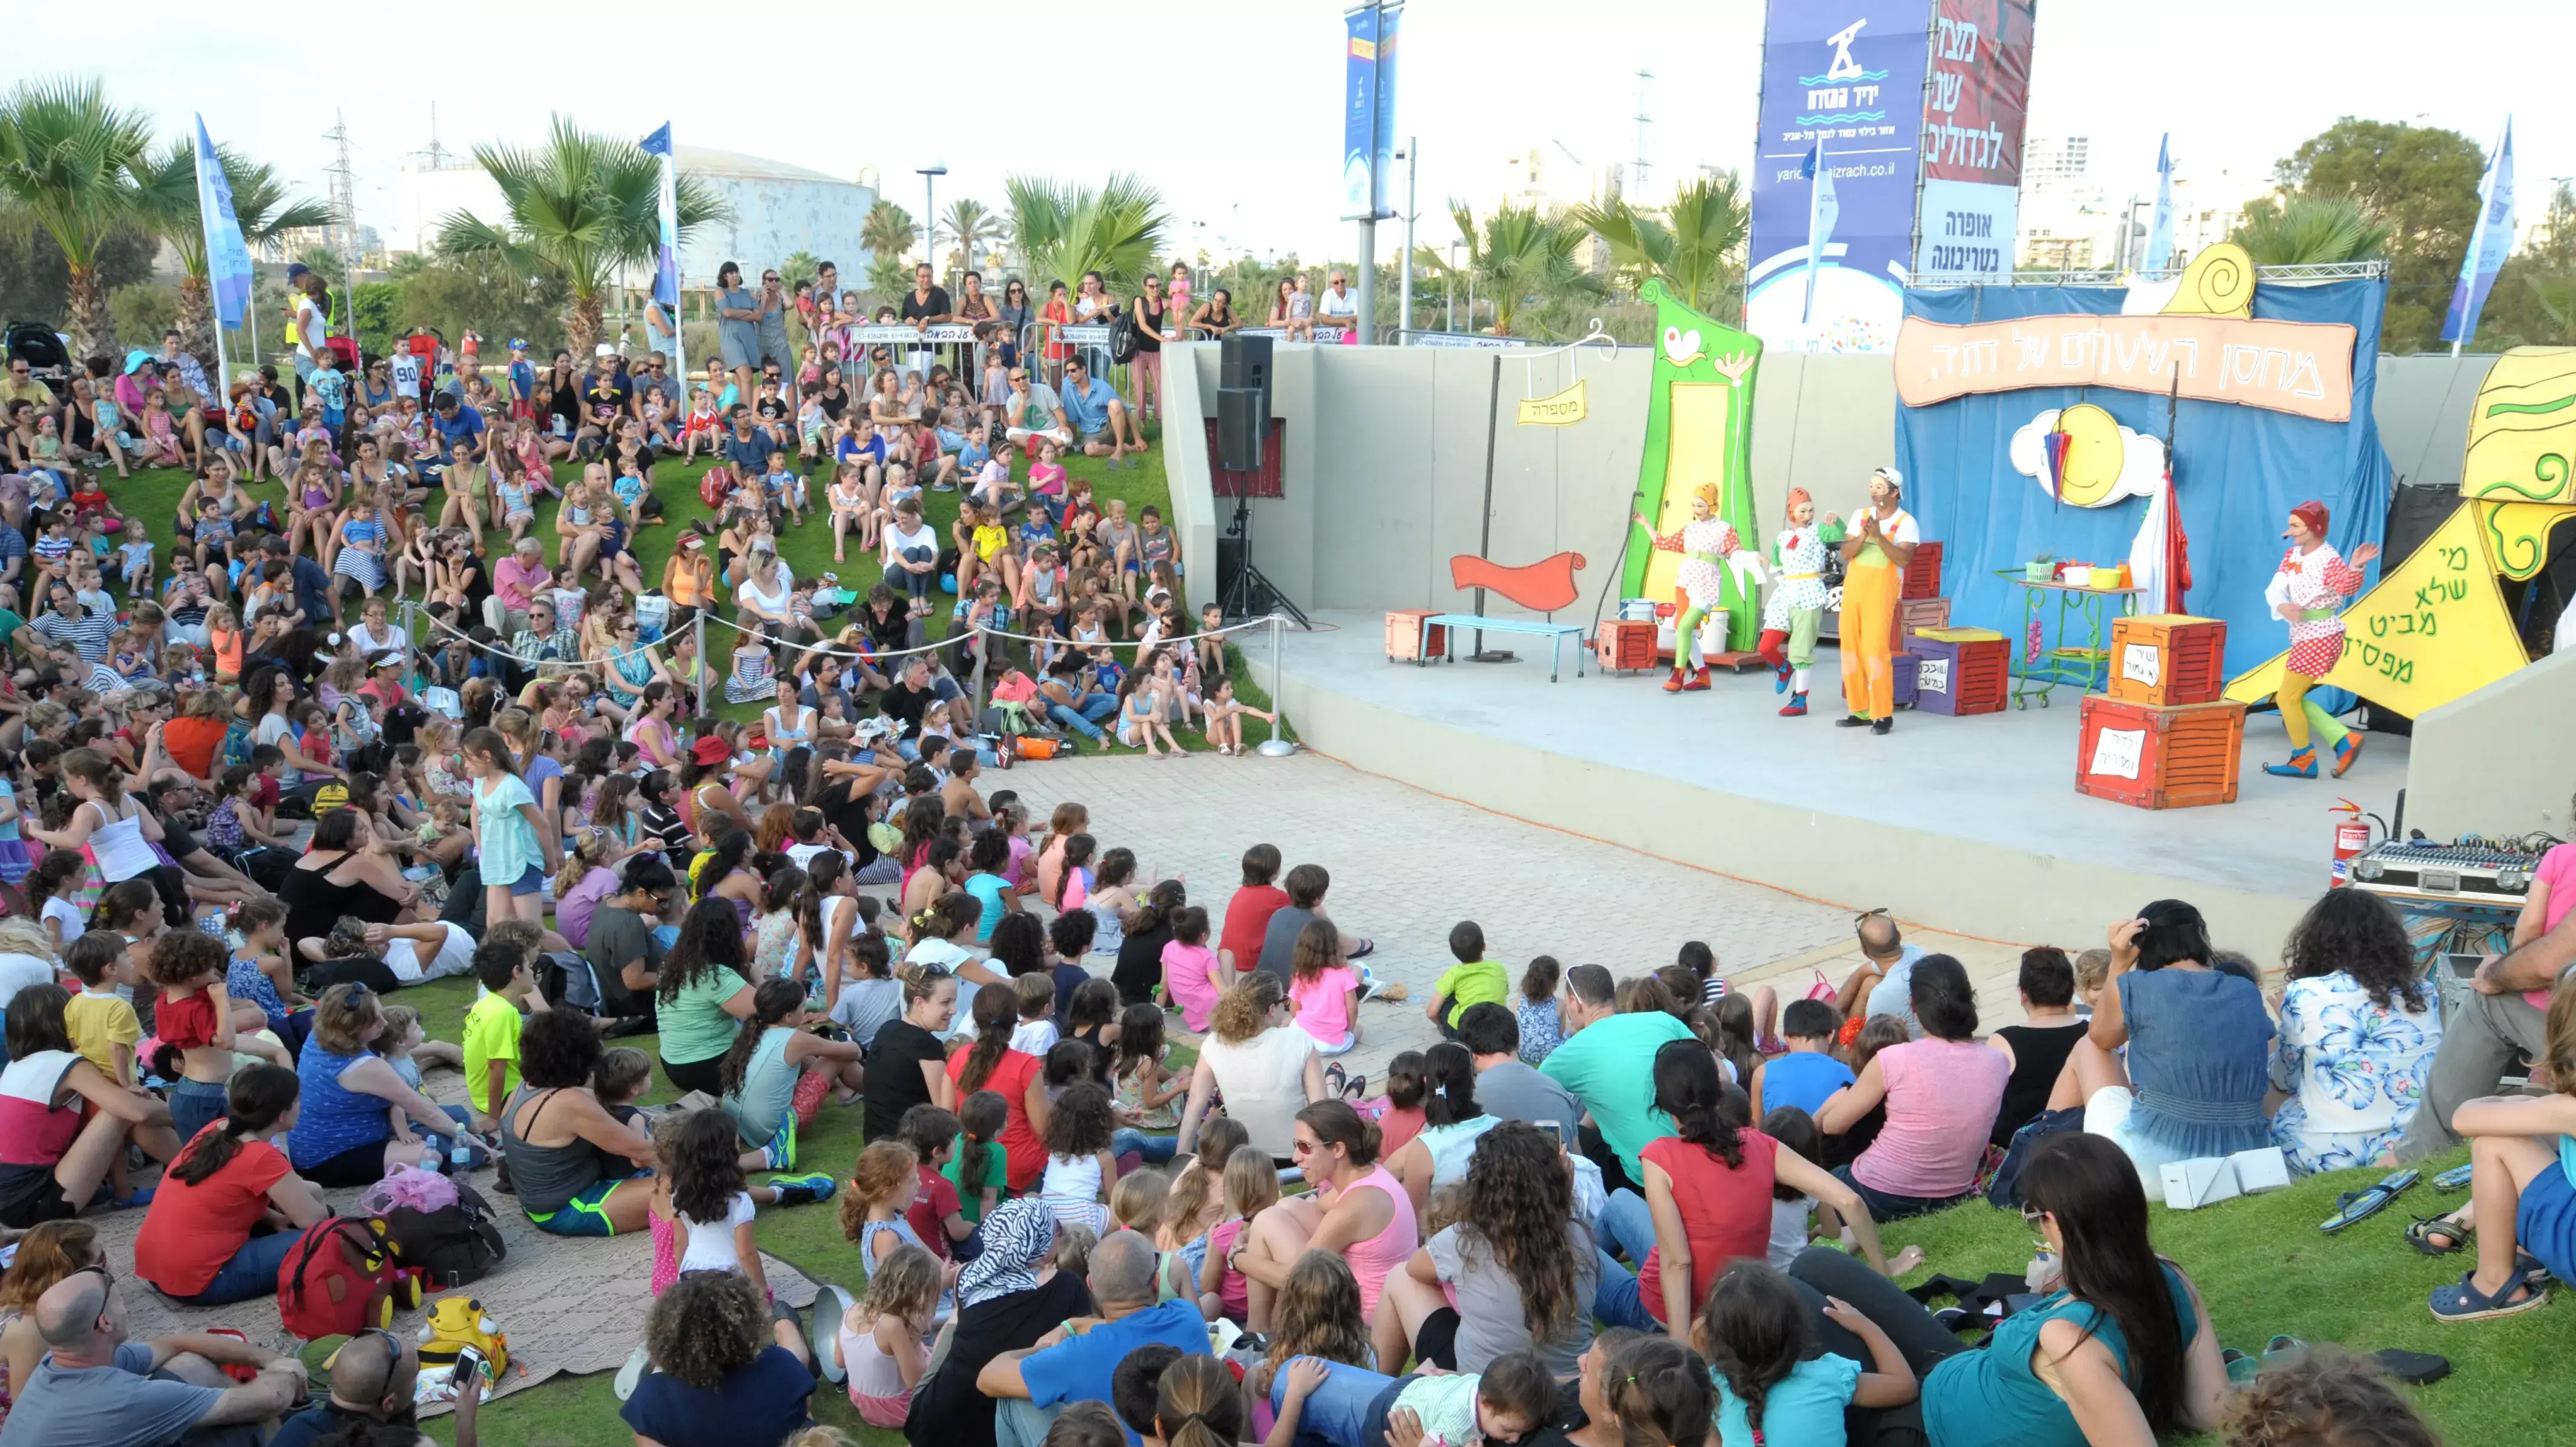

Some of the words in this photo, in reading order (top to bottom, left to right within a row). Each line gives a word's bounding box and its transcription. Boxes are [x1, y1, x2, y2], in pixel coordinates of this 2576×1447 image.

[1807, 87, 1848, 110] המזרח
[1853, 85, 1879, 107] יריד
[1926, 115, 2003, 169] לגדולים
[1945, 211, 1993, 238] אופרה
[1931, 244, 1999, 272] בטריבונה
[2012, 326, 2050, 372] של
[397, 367, 418, 382] 90
[2218, 344, 2325, 401] מחסן
[1531, 401, 1578, 416] מספרה
[2439, 546, 2468, 571] מי
[2415, 576, 2468, 610] שלא
[2370, 611, 2437, 638] מביט
[2135, 649, 2155, 661] שיר
[2343, 637, 2414, 684] מפסיד
[1919, 675, 1945, 689] במיטה
[2111, 734, 2138, 749] ילדה
